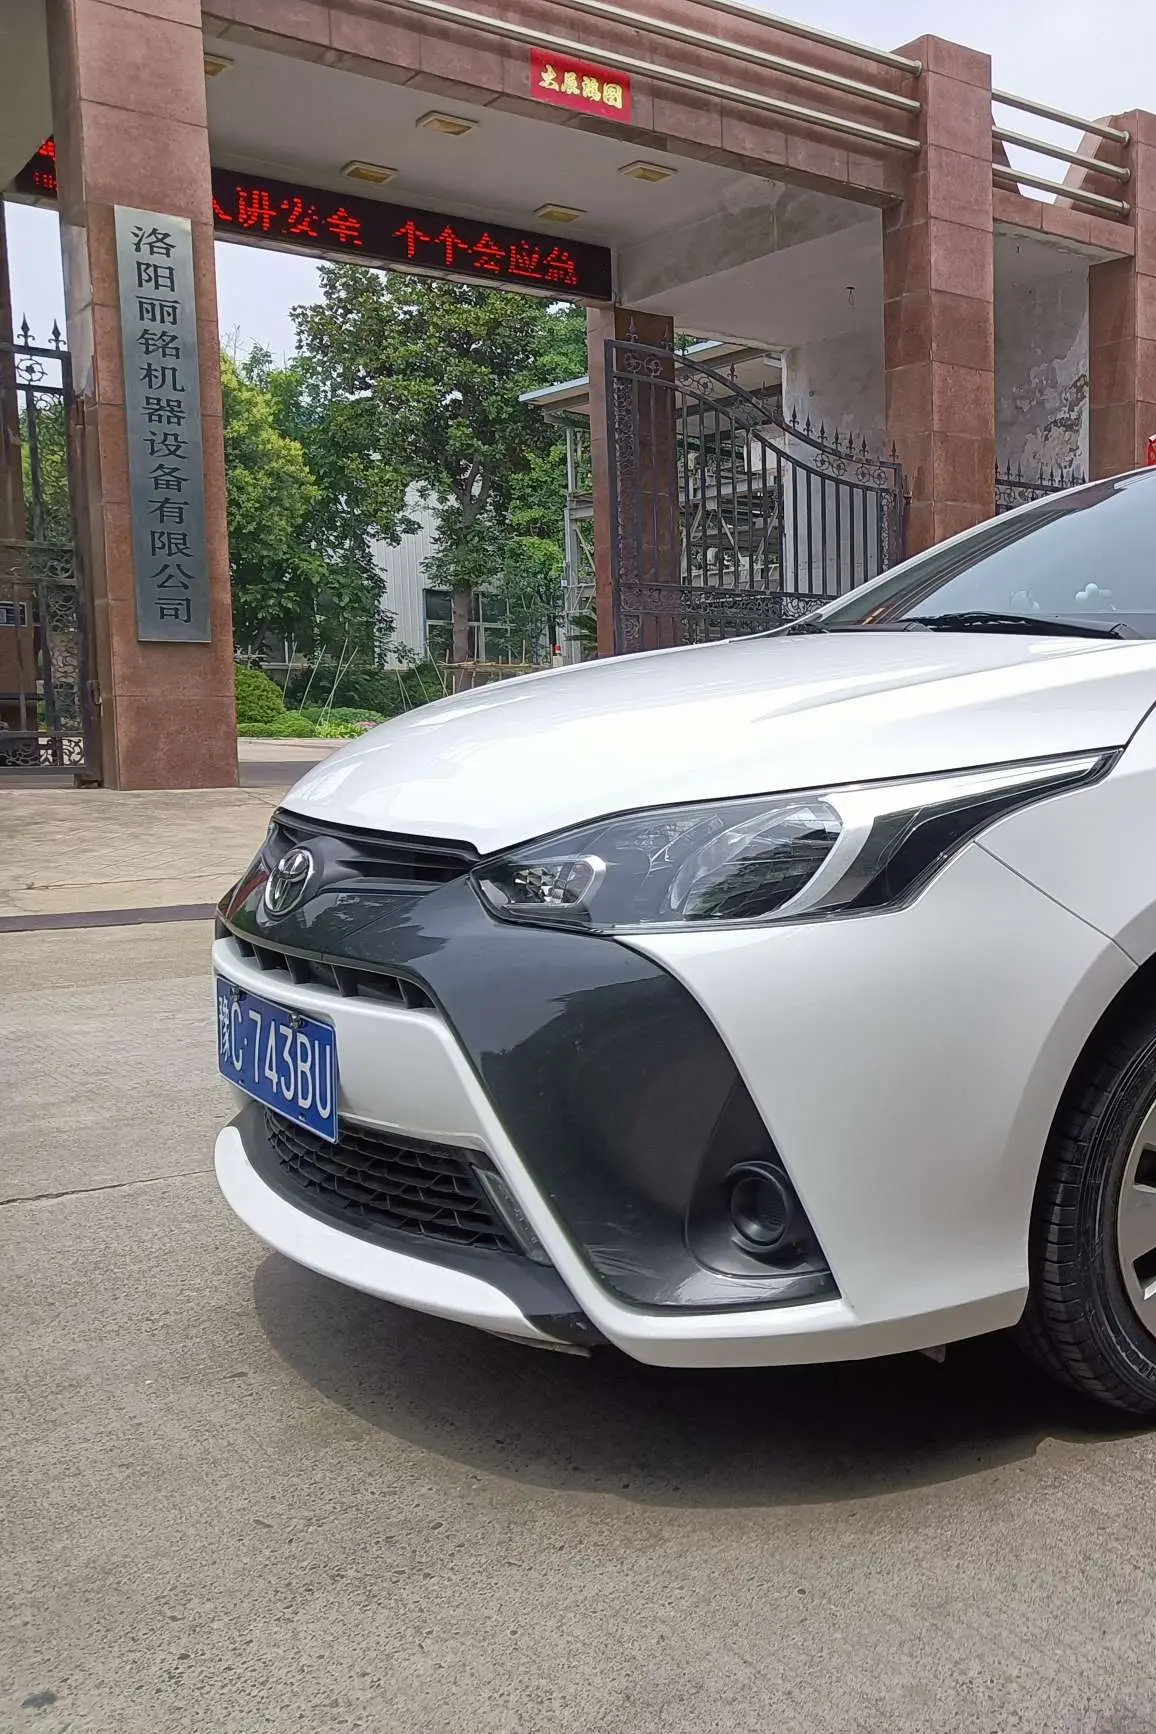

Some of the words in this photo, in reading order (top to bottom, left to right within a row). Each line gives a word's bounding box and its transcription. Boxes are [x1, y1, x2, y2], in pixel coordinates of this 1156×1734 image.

[130, 225, 195, 624] 洛阳丽铭机器设备有限公司
